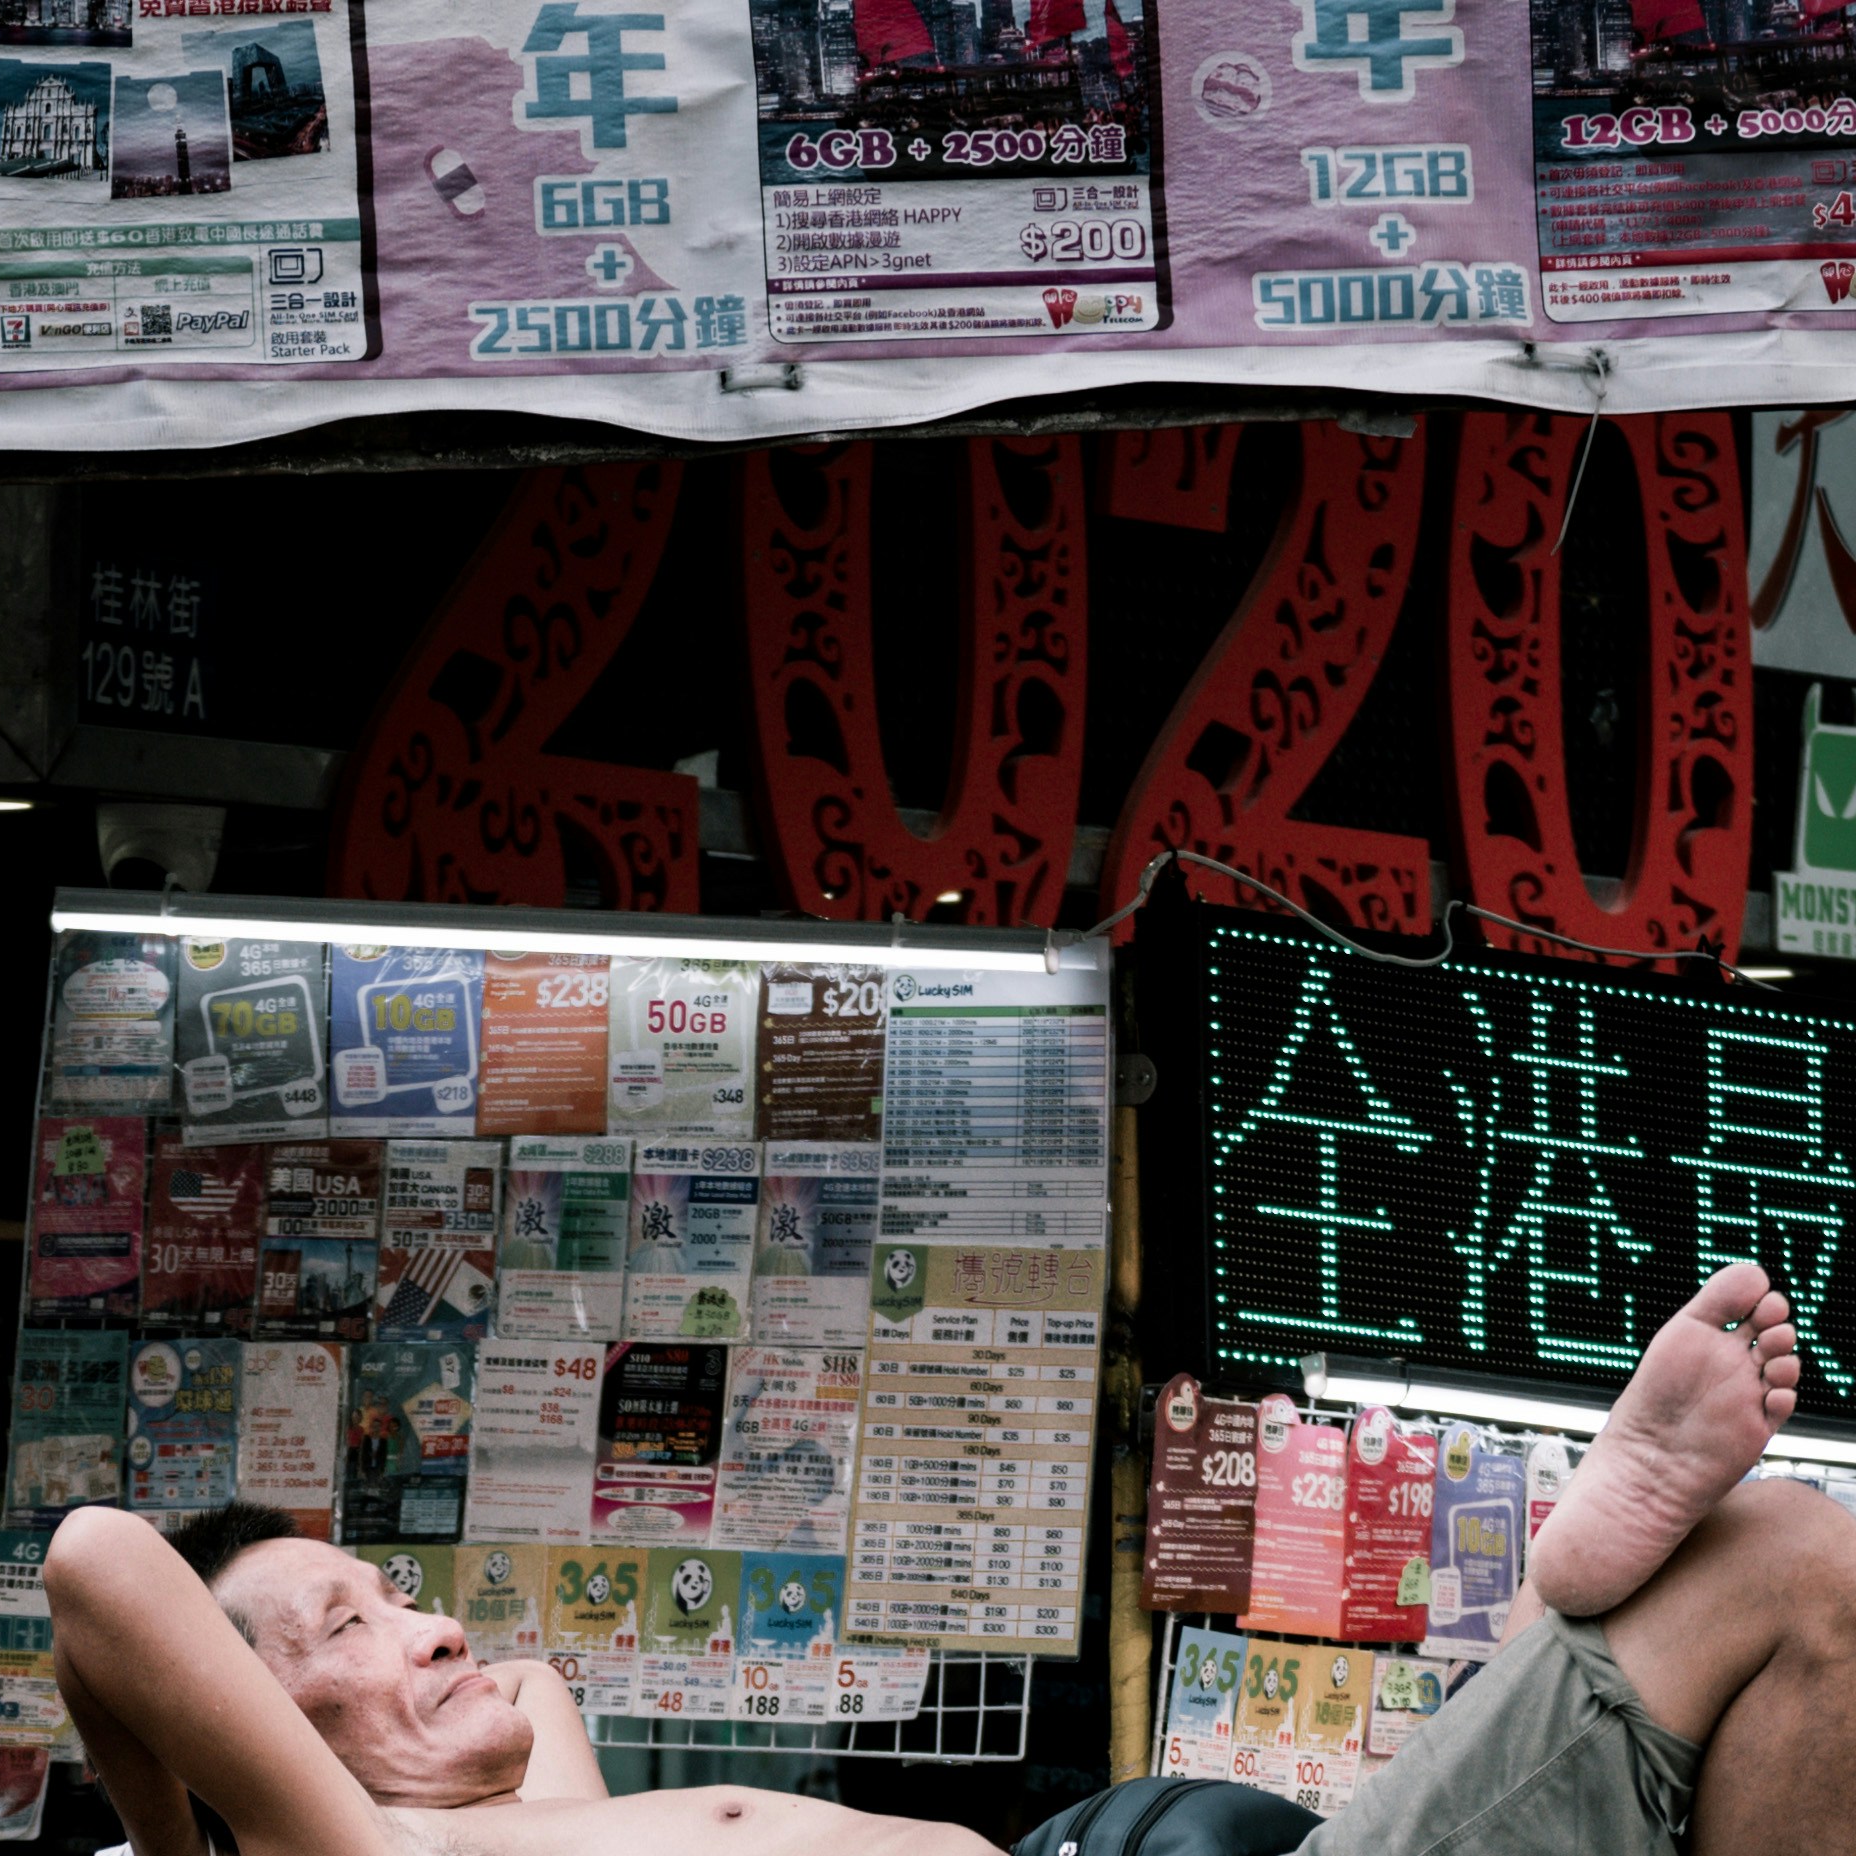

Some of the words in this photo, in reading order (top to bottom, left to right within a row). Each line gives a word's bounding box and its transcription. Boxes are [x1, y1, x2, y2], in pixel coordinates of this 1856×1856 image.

[522, 2, 678, 149] 年
[1561, 106, 1696, 149] 12GB
[787, 129, 898, 169] 6GB
[942, 130, 1046, 165] 2500
[1050, 124, 1127, 163] 分鐘
[1309, 150, 1466, 200] 12GB
[540, 178, 671, 229] 6GB
[774, 189, 881, 207] 簡易上網設定
[1073, 186, 1139, 200] 三合一設計
[904, 208, 962, 224] HAPPY
[1020, 220, 1144, 262] $200
[87, 261, 141, 276] 充值方法
[9, 283, 79, 298] 香港及澳門
[270, 292, 357, 309] 三合一設計
[1259, 268, 1528, 326] 5000分鐘
[176, 311, 249, 331] PayPal
[476, 294, 748, 354] 2500分鐘
[271, 344, 317, 358] Starter
[320, 342, 351, 356] Pack
[89, 563, 202, 642] 桂林街
[536, 973, 608, 1009] $238
[212, 1001, 297, 1038] 70GB
[372, 994, 455, 1031] 10GB
[647, 999, 727, 1034] 50GB
[436, 1085, 468, 1103] $218
[712, 1088, 744, 1106] $348
[583, 1143, 625, 1166] $288
[701, 1147, 755, 1172] $238
[269, 1167, 314, 1193] 美國
[316, 1175, 361, 1196] USA
[691, 1207, 721, 1221] 20GB
[690, 1232, 718, 1246] 2000
[932, 1315, 959, 1325] Service
[961, 1315, 978, 1325] Plan
[1010, 1317, 1029, 1328] Price
[554, 1357, 597, 1380] $48
[1201, 1450, 1257, 1488] $208
[1291, 1471, 1343, 1511] $238
[1387, 1483, 1434, 1518] $198
